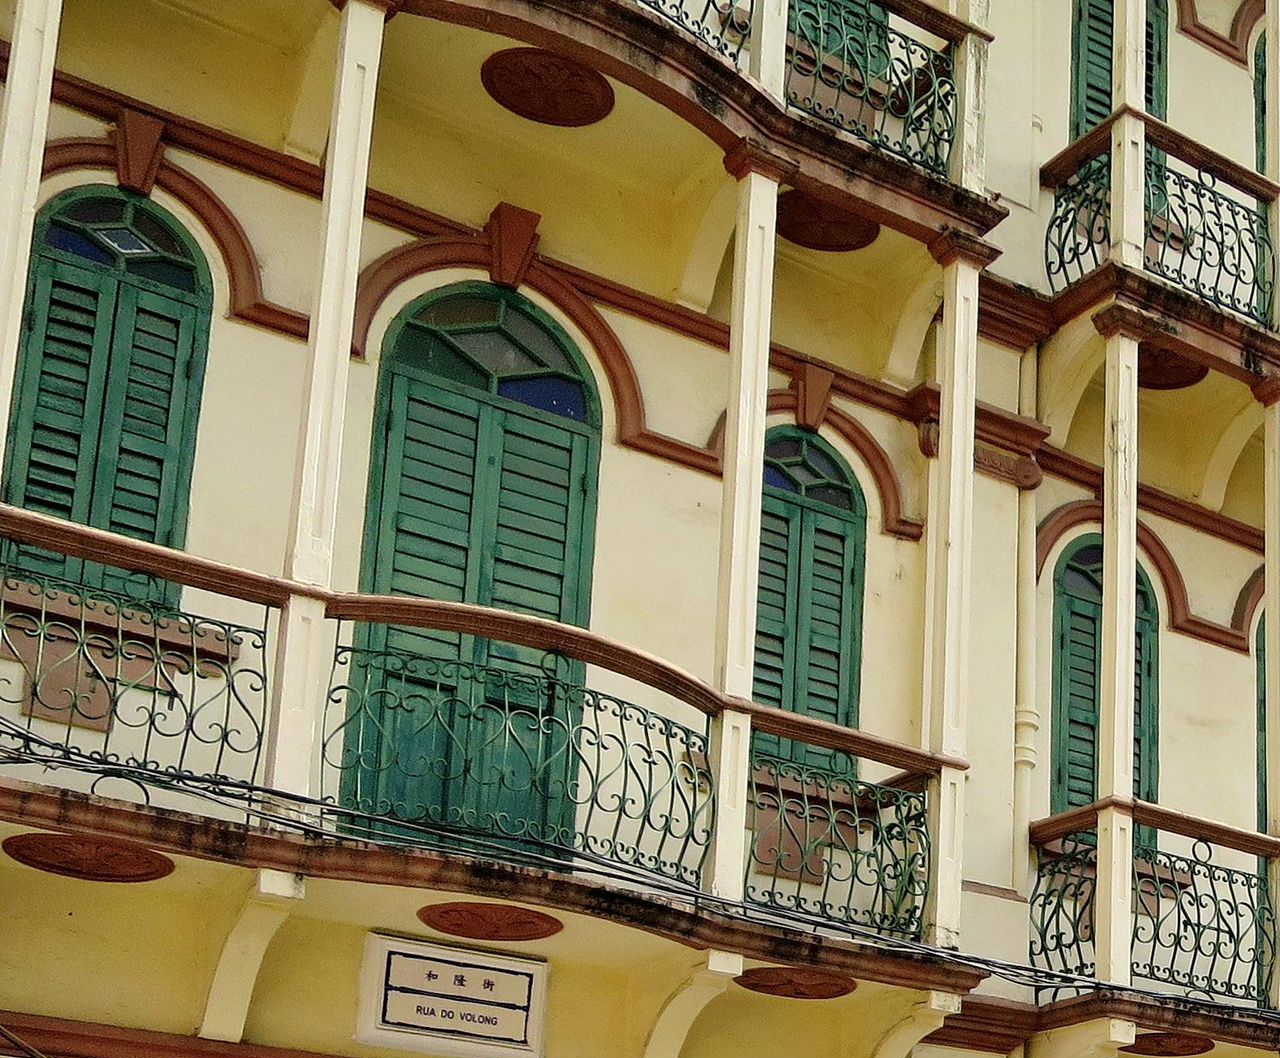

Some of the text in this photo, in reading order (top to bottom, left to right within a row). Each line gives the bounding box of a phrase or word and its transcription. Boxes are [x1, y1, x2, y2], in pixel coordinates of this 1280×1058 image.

[425, 970, 496, 991] 和隆街
[415, 1005, 498, 1025] RUA DO VOLONG
